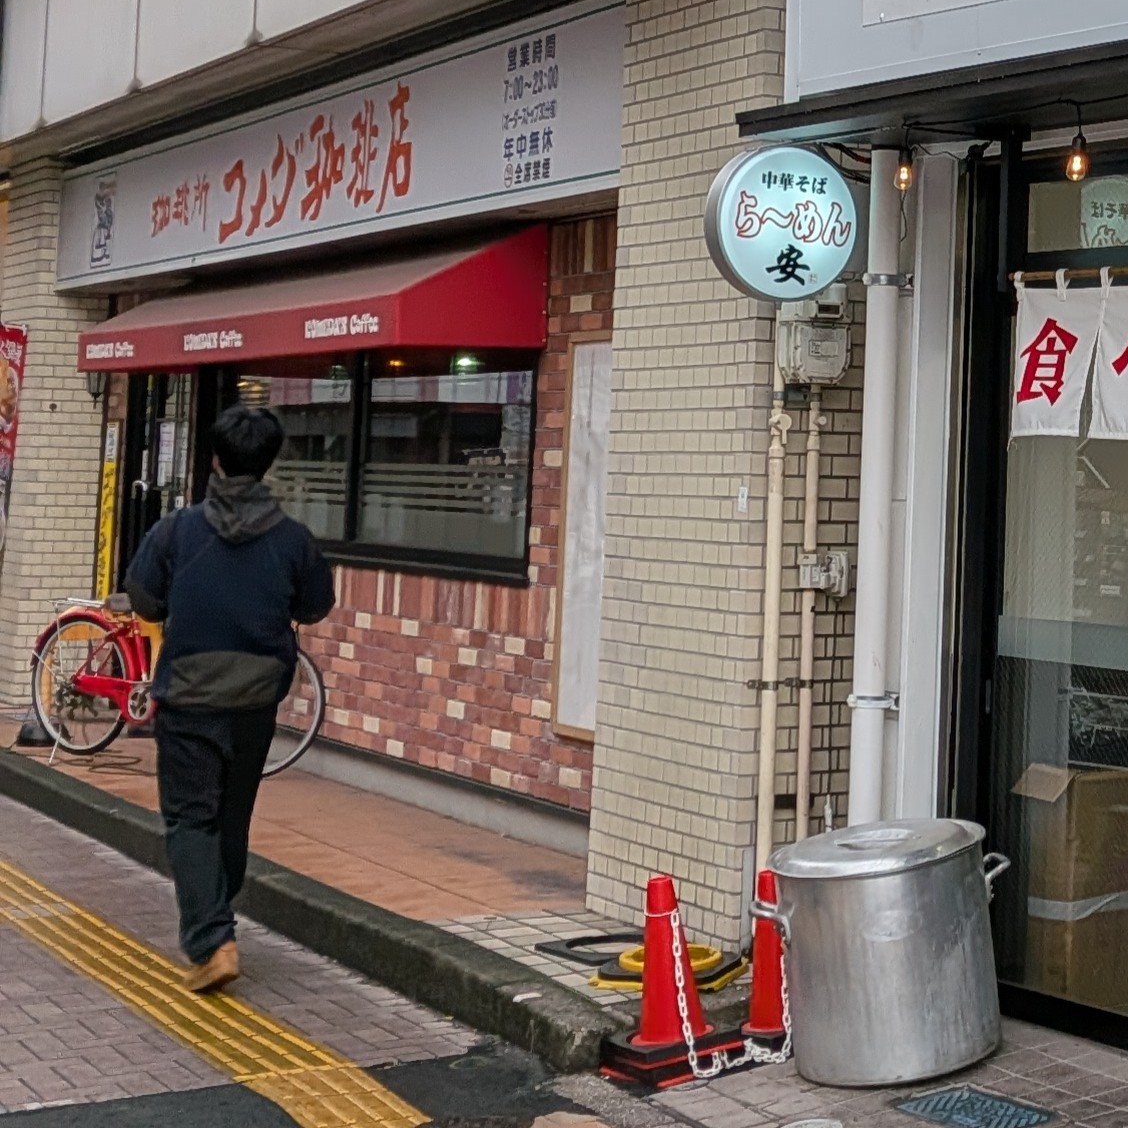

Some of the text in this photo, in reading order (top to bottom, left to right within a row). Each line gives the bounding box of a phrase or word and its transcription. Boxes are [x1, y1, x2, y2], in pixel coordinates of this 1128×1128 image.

[218, 81, 414, 245] コメダ珈琲店
[503, 126, 553, 162] 年中無休
[762, 171, 828, 195] 中華そば
[765, 243, 811, 286] 安
